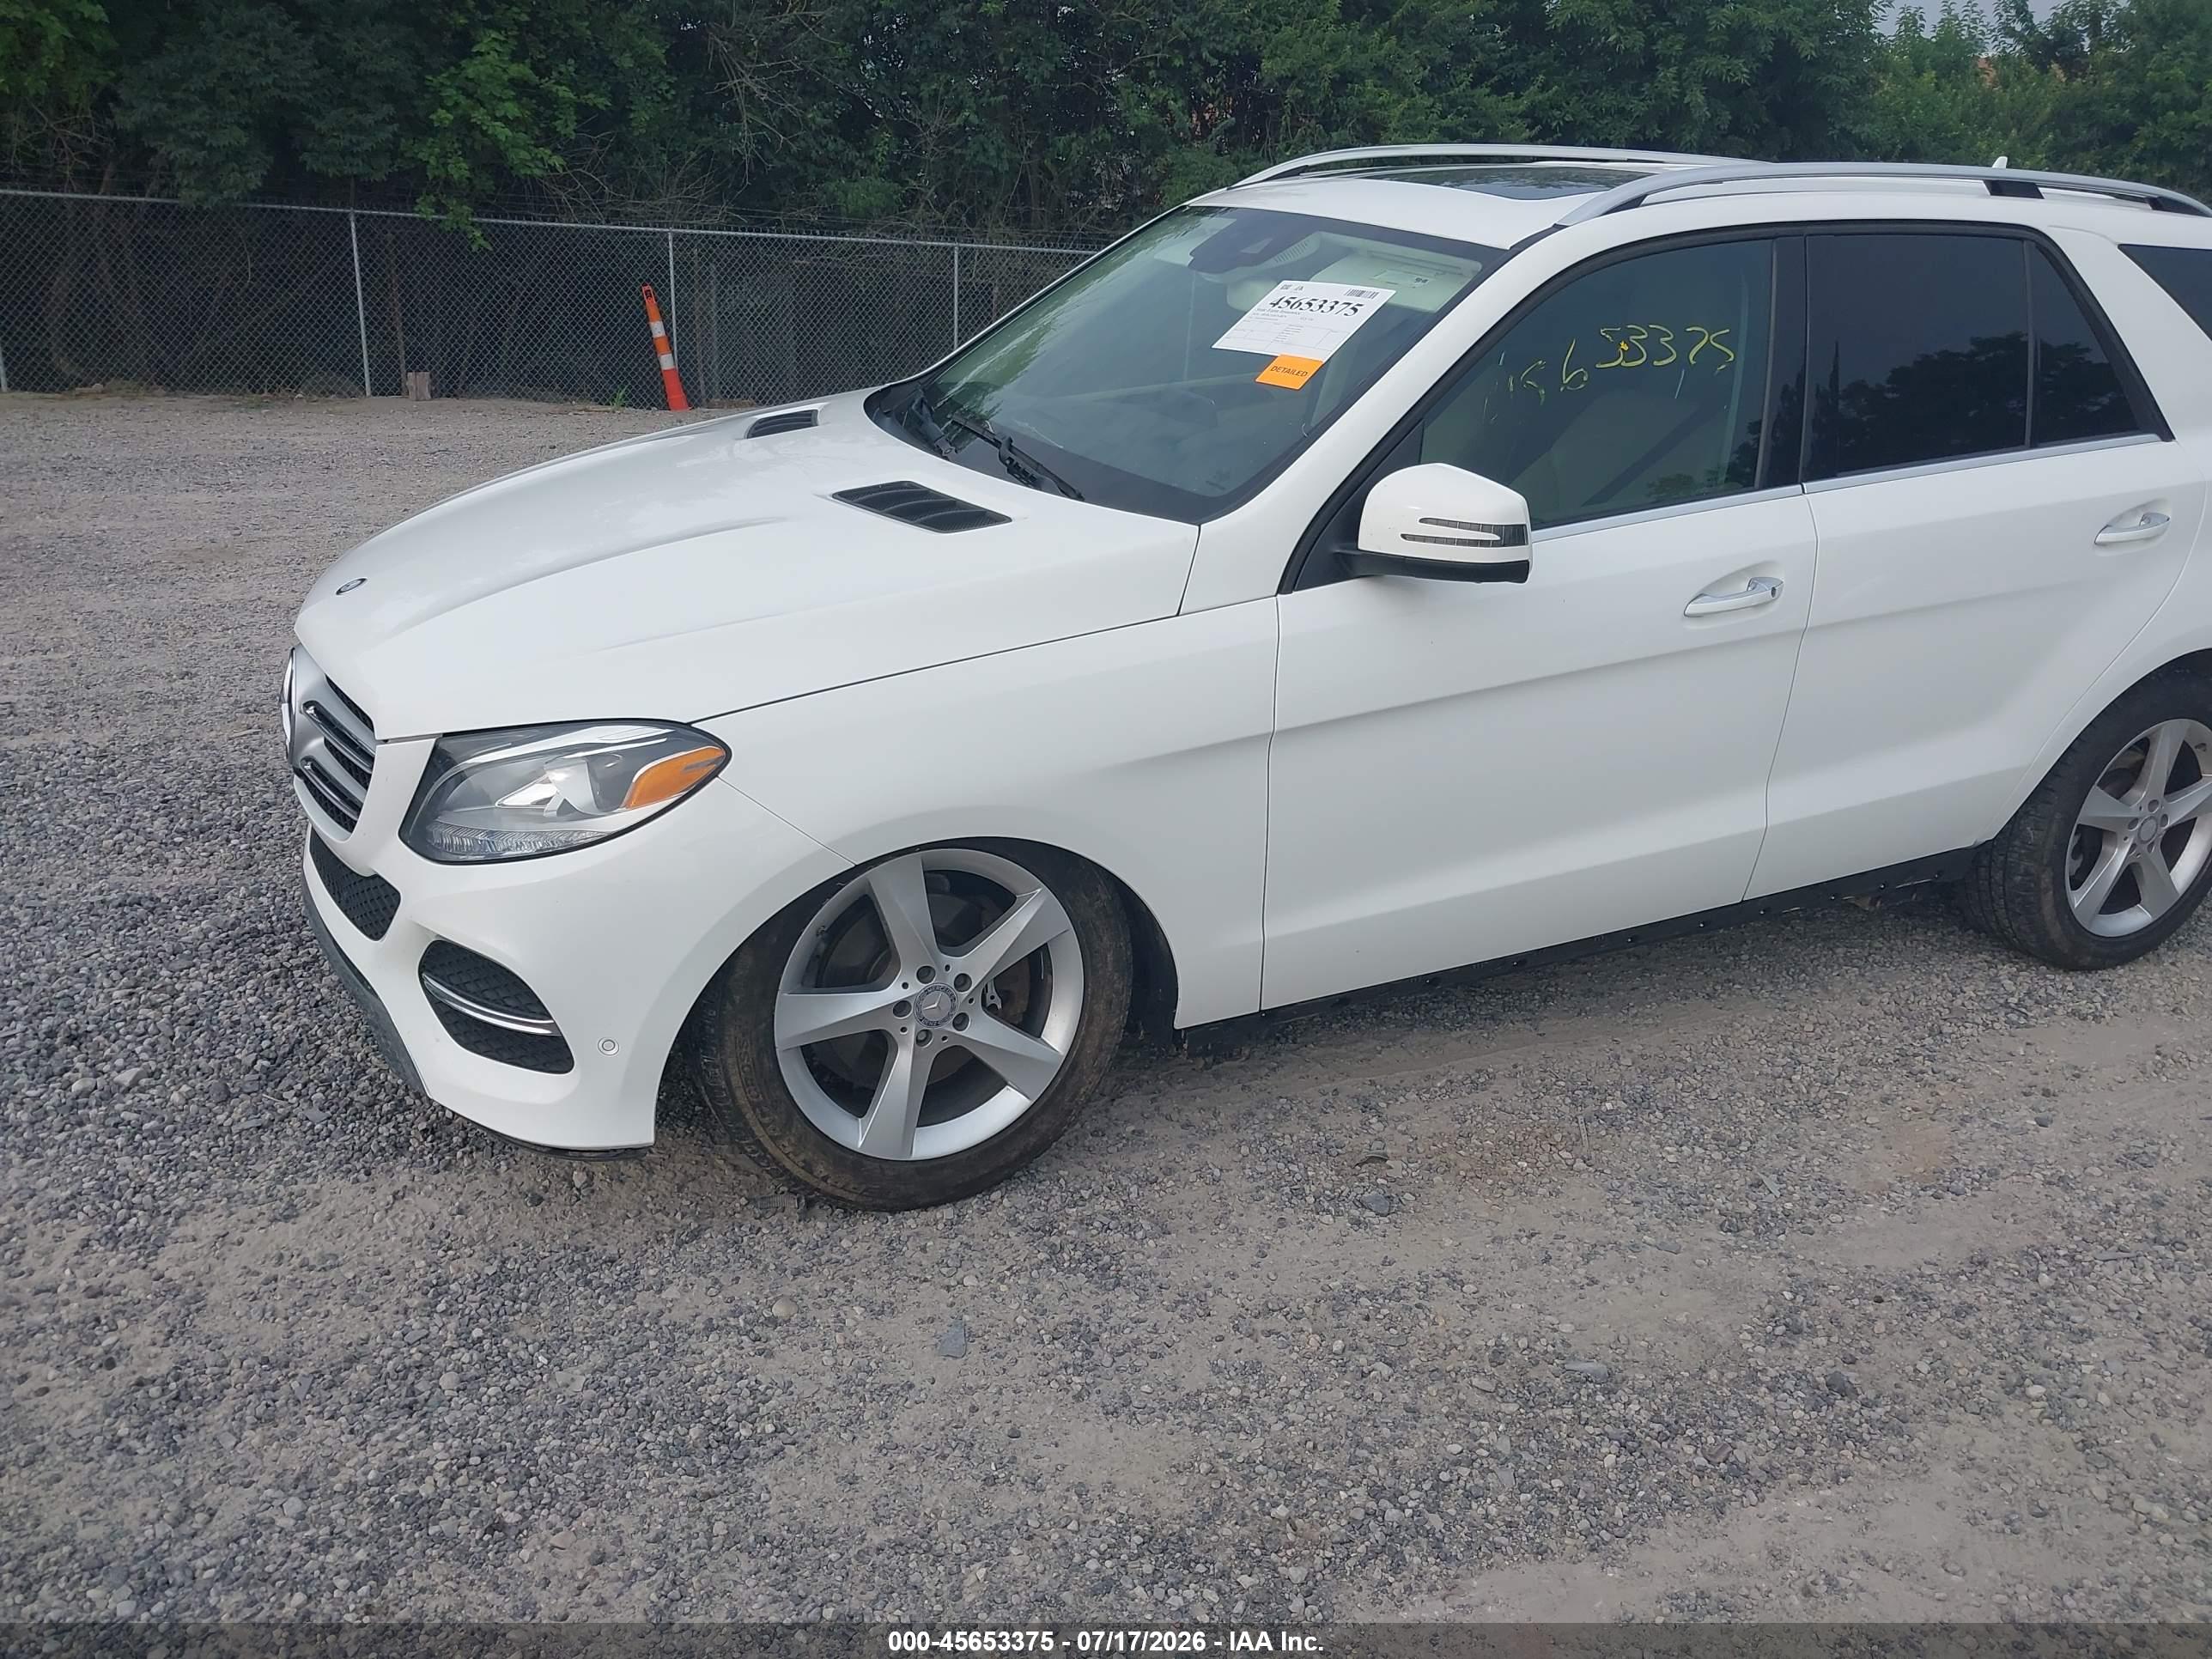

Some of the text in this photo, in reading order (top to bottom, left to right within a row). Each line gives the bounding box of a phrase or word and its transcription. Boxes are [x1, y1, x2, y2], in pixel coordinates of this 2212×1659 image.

[1269, 295, 1364, 317] 45653375
[1270, 365, 1309, 378] DETAILED
[1498, 324, 1735, 405] 5653375
